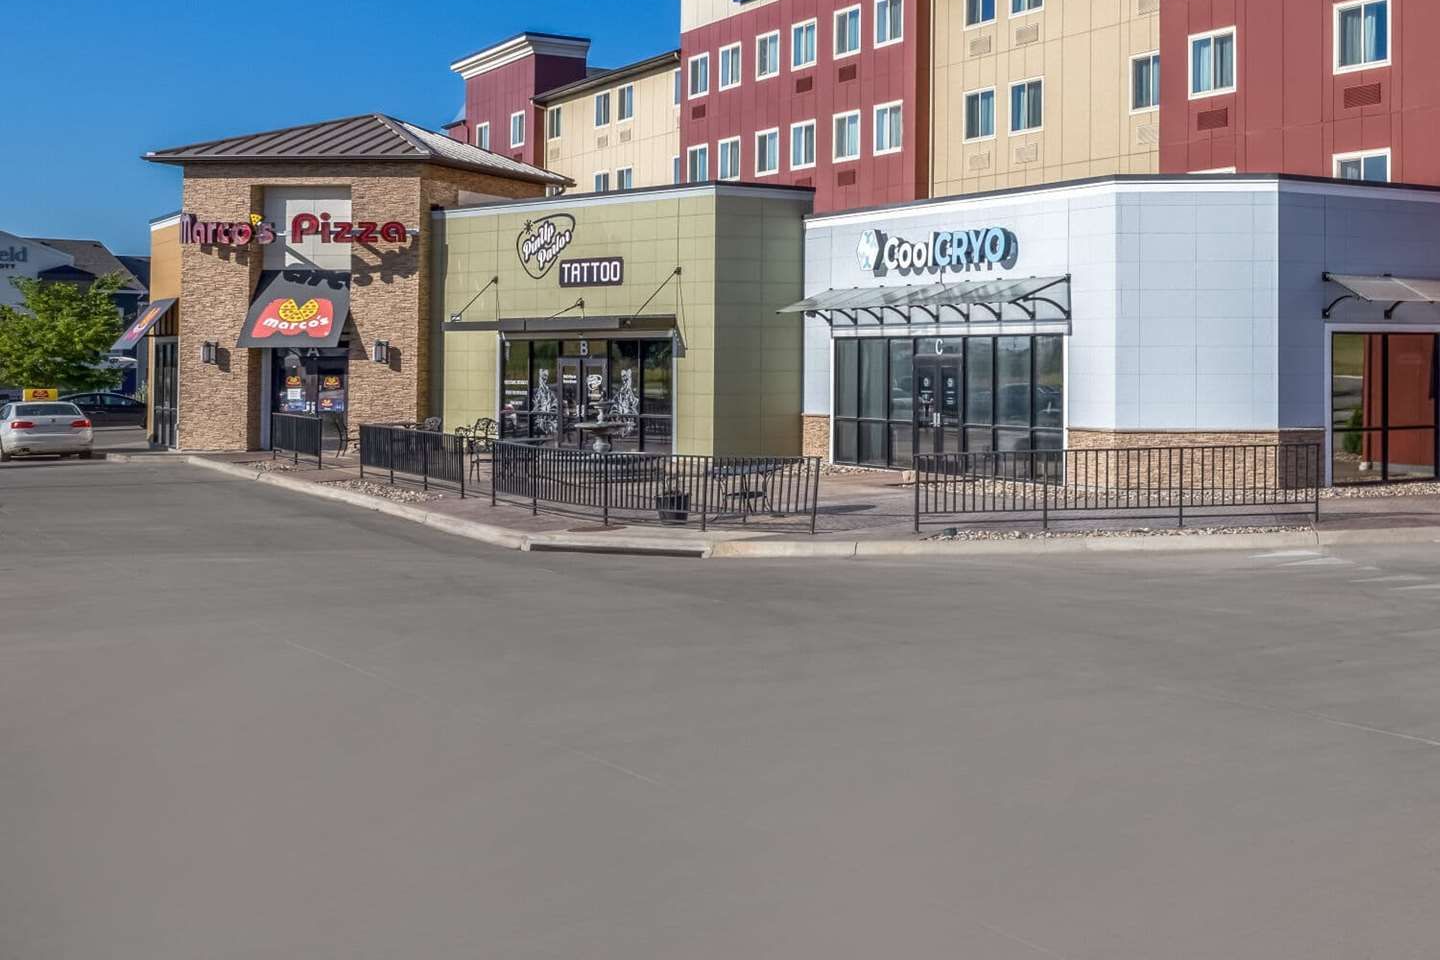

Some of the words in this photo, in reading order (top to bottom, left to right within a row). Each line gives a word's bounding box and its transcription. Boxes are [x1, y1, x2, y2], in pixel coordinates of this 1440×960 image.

[180, 213, 275, 245] Marco's
[291, 212, 407, 244] Pizza
[883, 226, 1006, 270] CoolCRYO
[561, 261, 621, 283] TATTOO
[580, 340, 588, 356] B
[935, 338, 943, 355] C
